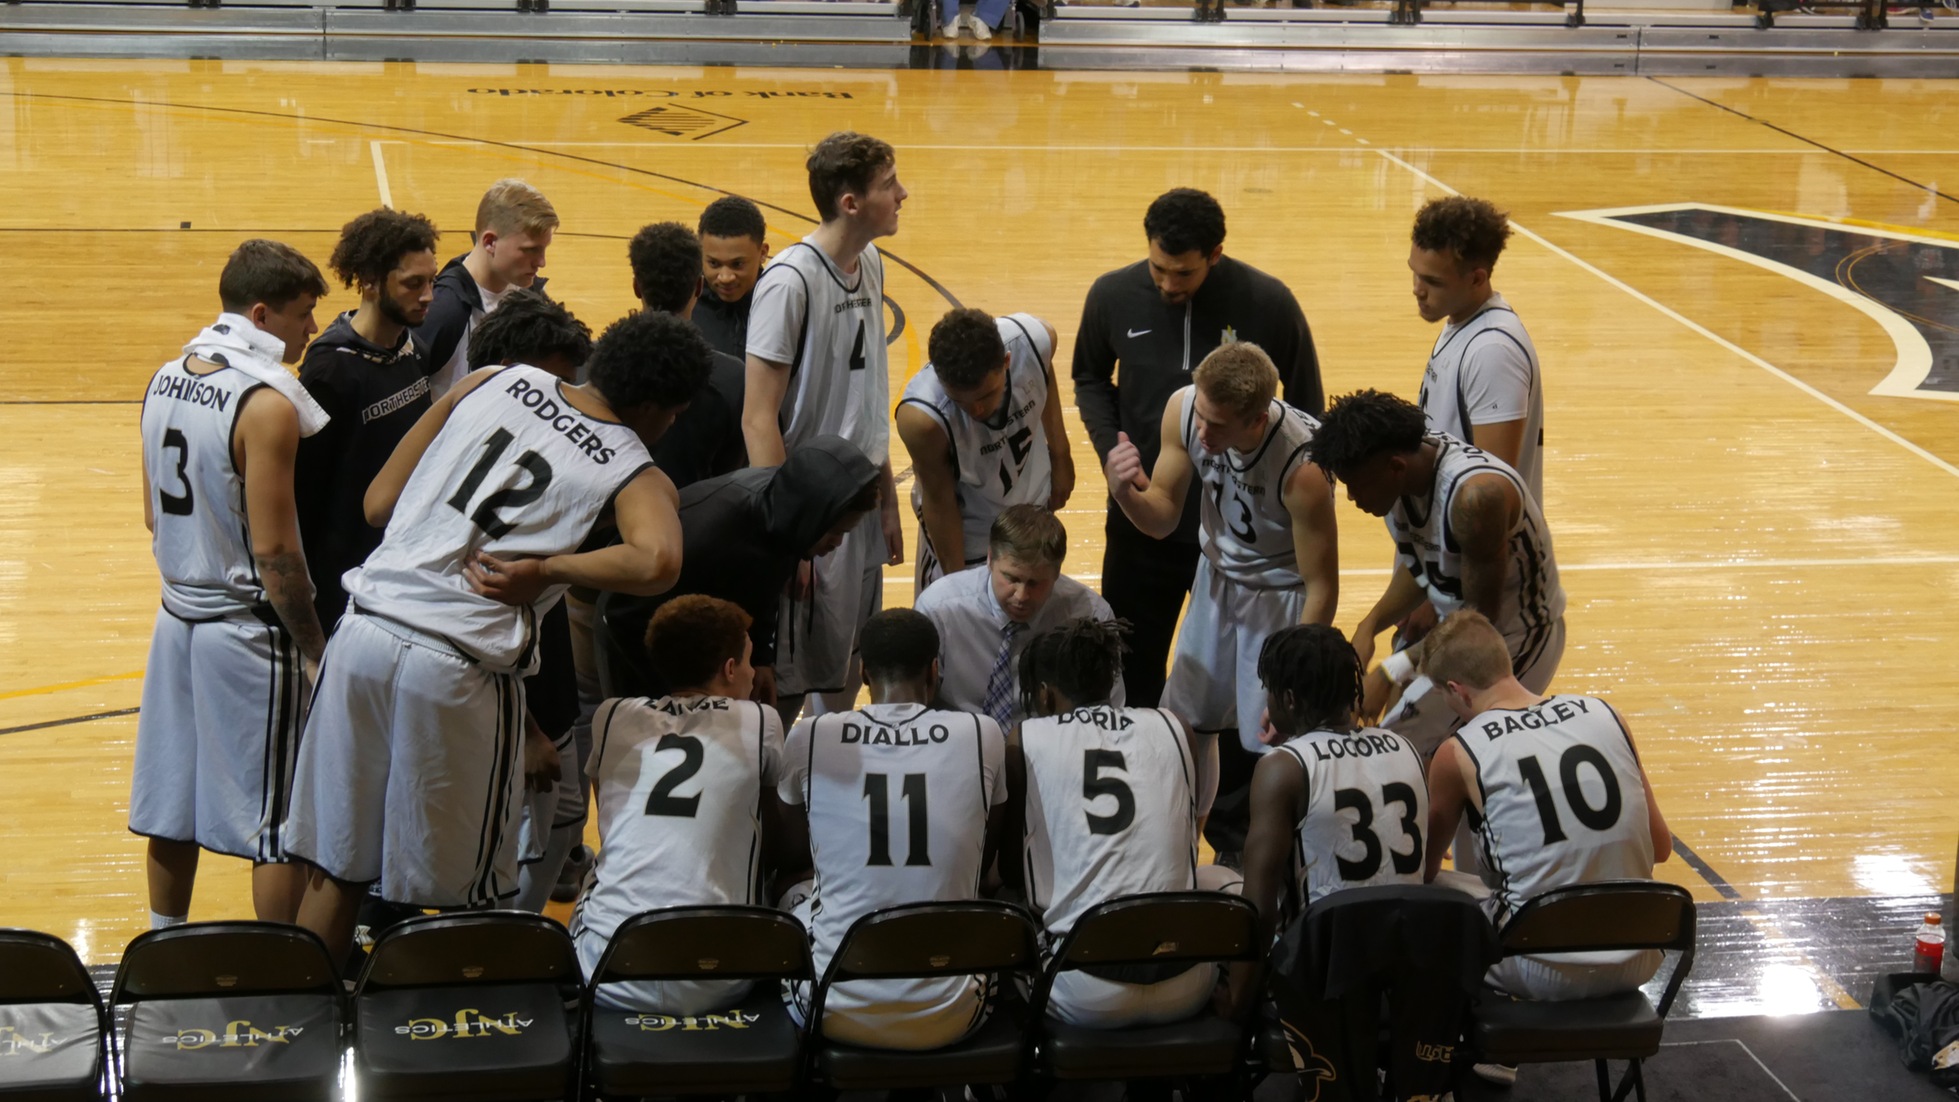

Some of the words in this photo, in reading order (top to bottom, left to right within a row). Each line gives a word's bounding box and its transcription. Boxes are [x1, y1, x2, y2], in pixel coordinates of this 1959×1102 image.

[467, 88, 679, 98] Colorado
[744, 91, 853, 99] Bank
[153, 375, 232, 412] JOHNSON
[506, 378, 616, 465] RODGERS
[159, 427, 194, 516] 3
[447, 427, 553, 541] 12
[841, 723, 949, 746] DIALLO
[1058, 708, 1135, 731] DORIA
[1481, 698, 1591, 741] BAGLEY
[1310, 733, 1401, 761] LOCORO
[644, 732, 705, 818] 2
[1083, 748, 1136, 836] 5
[1517, 744, 1623, 847] 10
[862, 773, 933, 867] 11
[1334, 781, 1424, 881] 33
[162, 1027, 304, 1045] ATHLETICS
[394, 1018, 534, 1035] ATHLETICS
[624, 1013, 760, 1026] ATHLETICS
